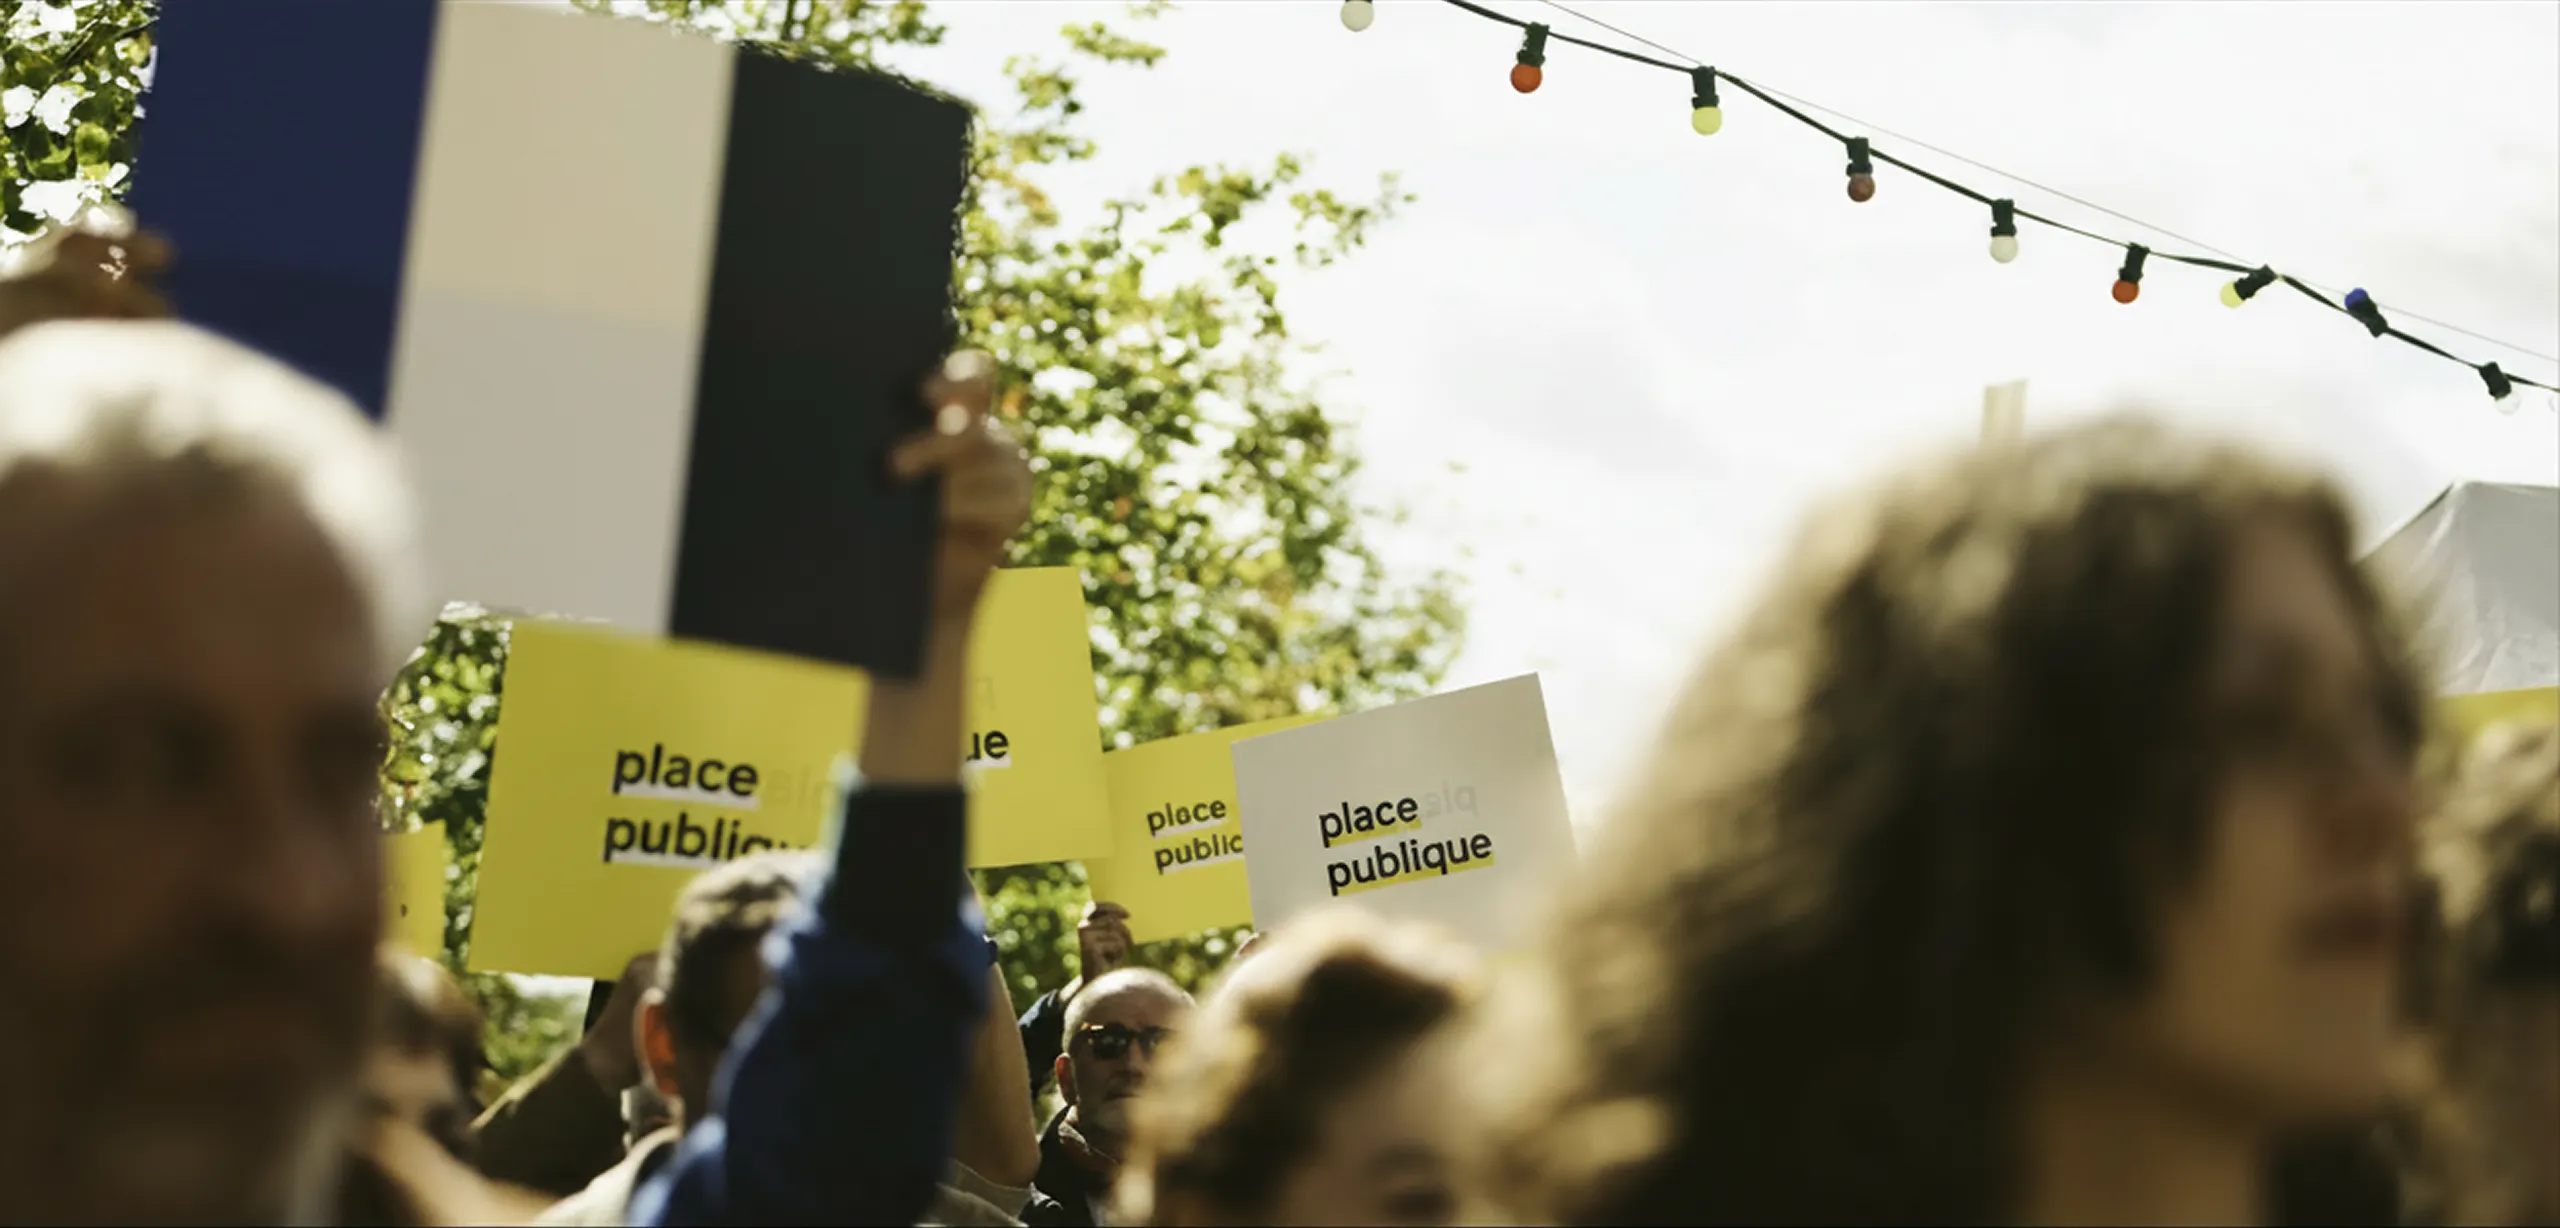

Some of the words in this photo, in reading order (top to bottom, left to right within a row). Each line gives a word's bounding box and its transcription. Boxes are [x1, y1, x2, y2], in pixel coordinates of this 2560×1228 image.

[612, 742, 758, 797] place
[1147, 799, 1226, 838] place
[1318, 797, 1418, 849] place
[1327, 833, 1492, 897] publique
